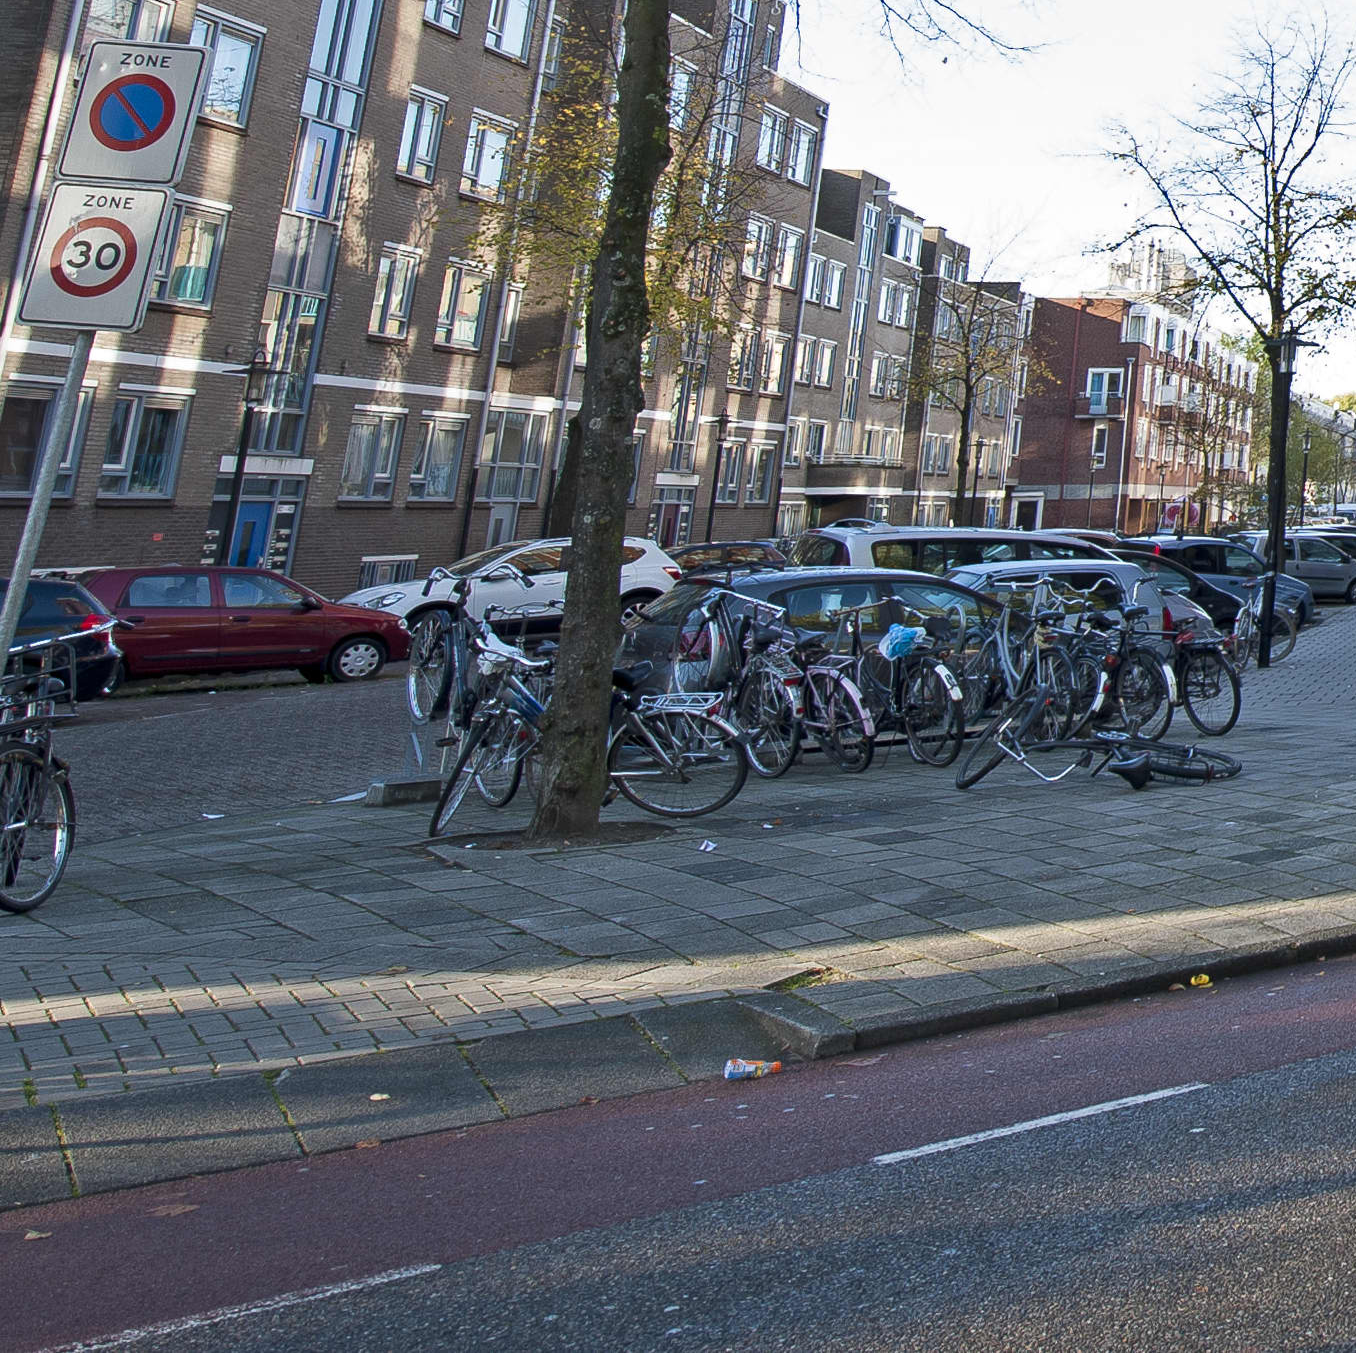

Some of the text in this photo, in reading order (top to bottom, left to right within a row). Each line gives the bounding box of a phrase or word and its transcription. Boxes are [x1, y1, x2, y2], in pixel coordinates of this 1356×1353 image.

[120, 52, 173, 69] ZONE
[82, 194, 135, 211] ZONE
[66, 239, 122, 272] 30
